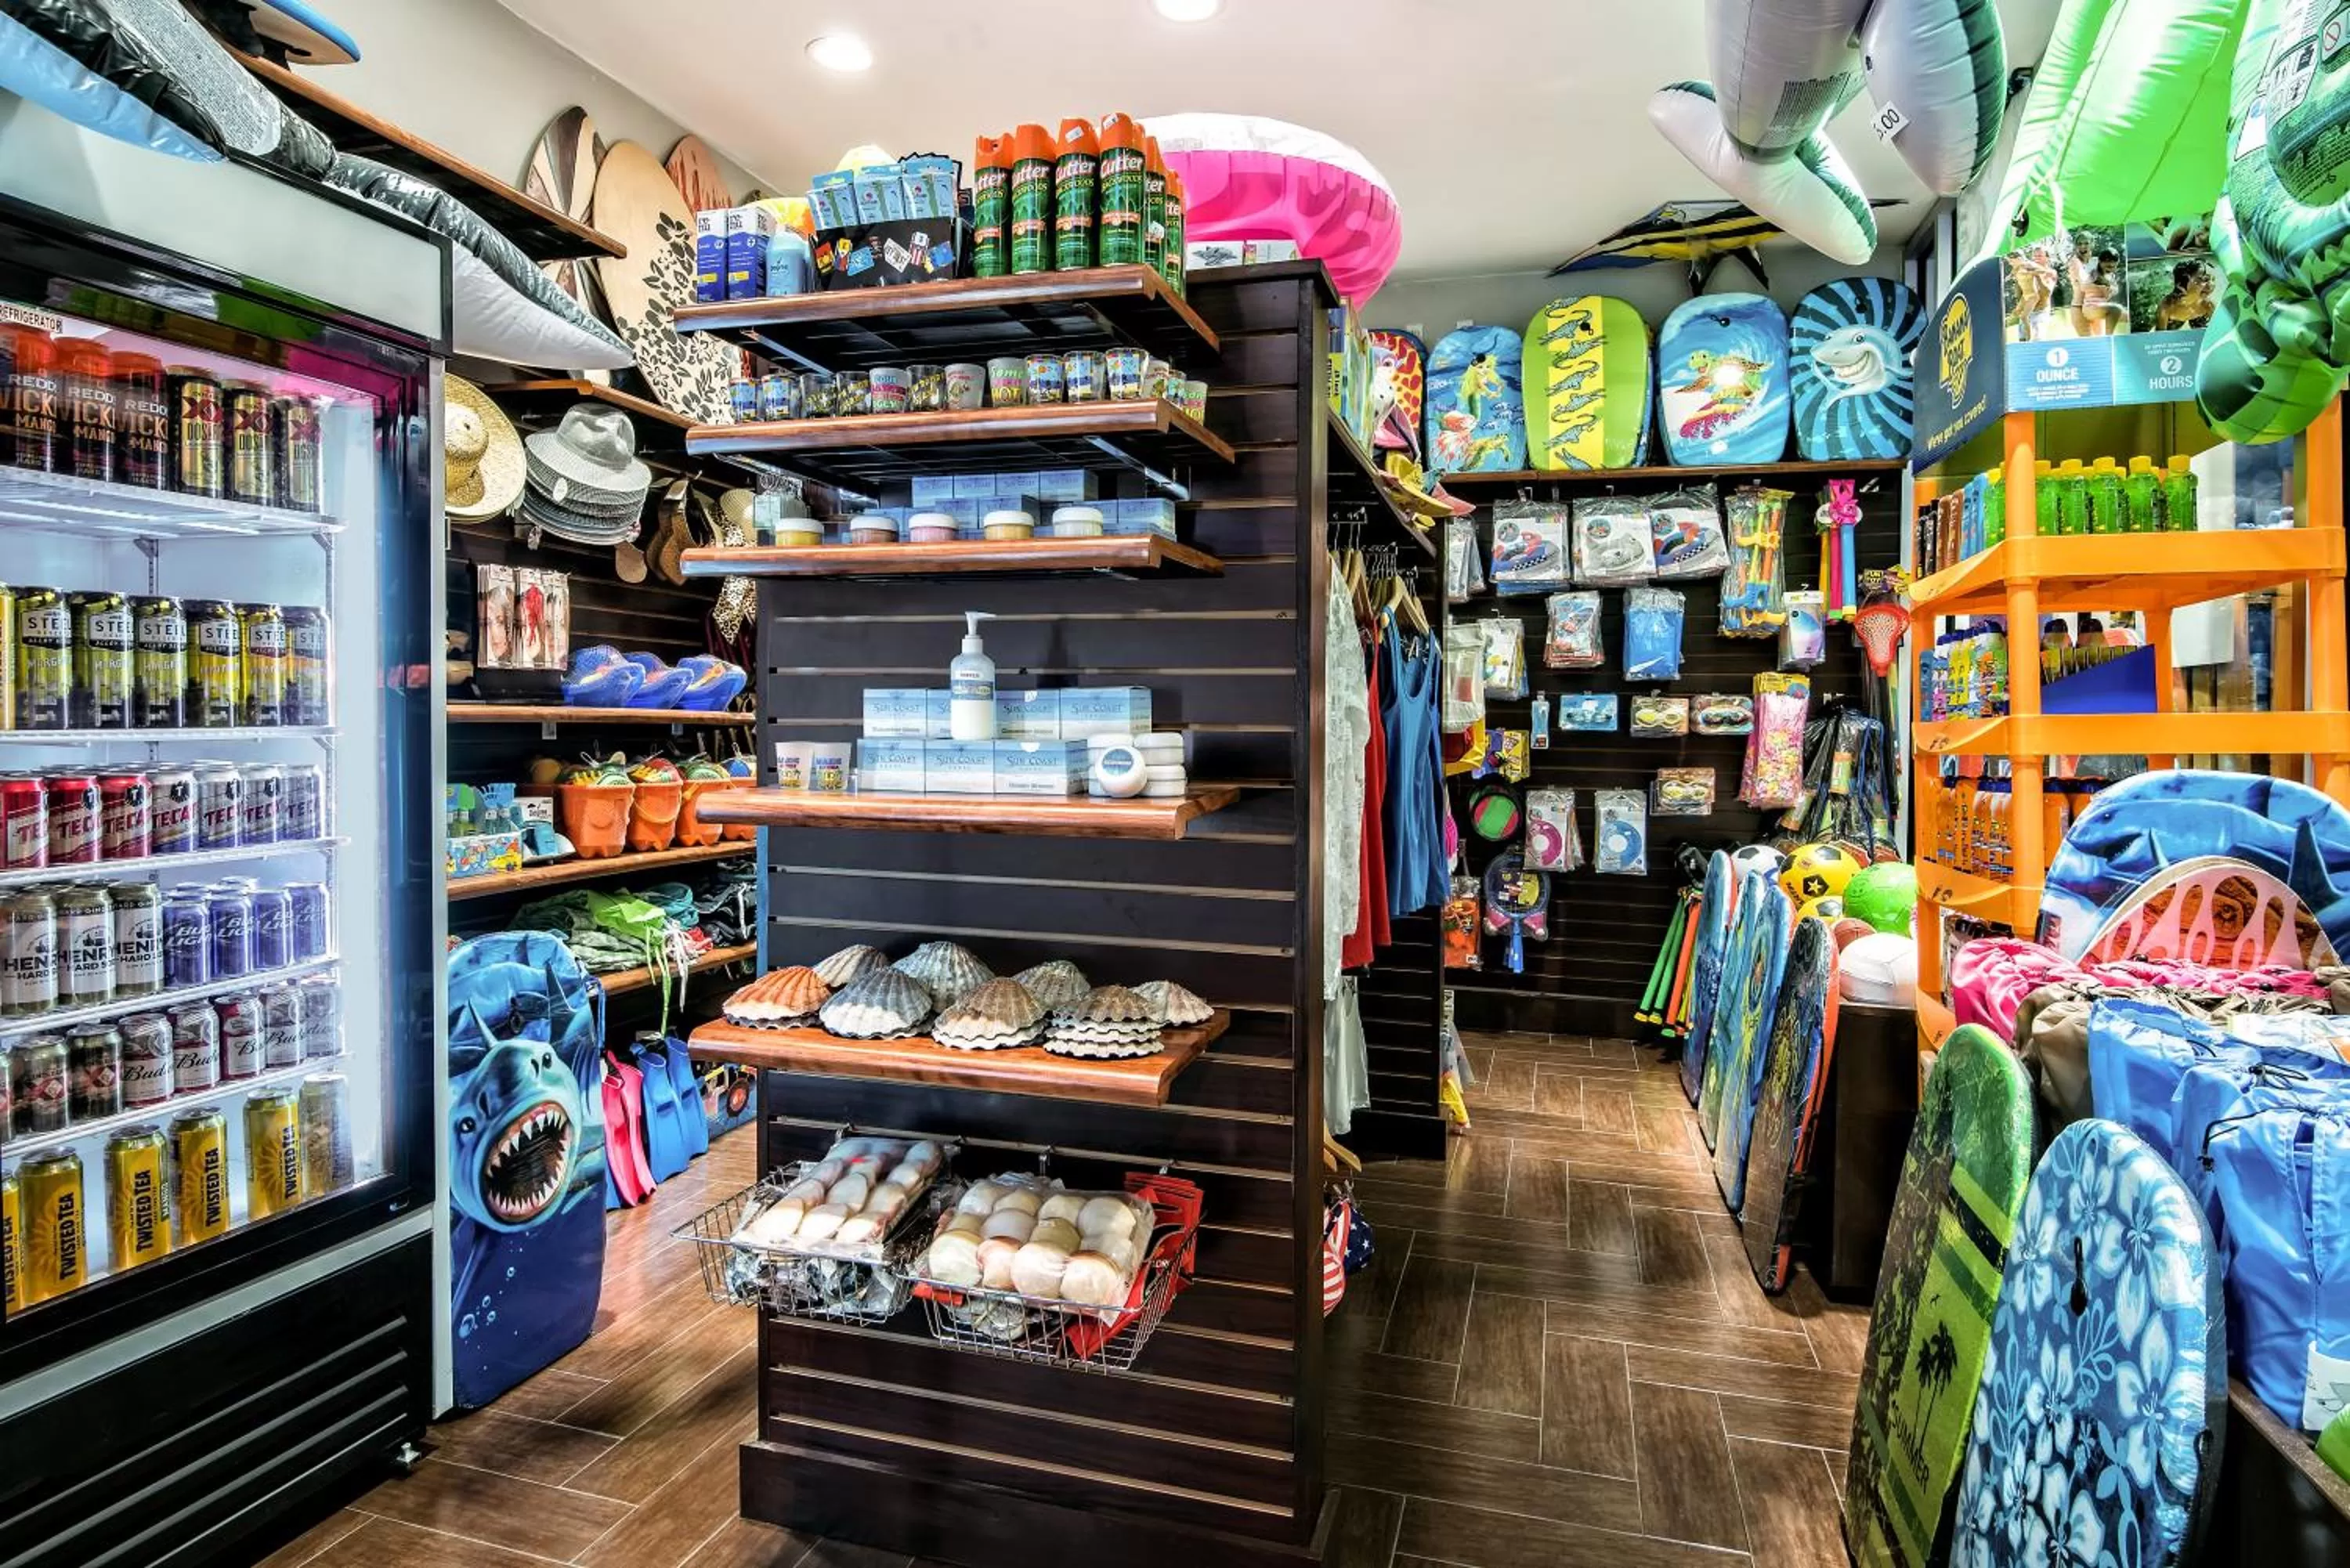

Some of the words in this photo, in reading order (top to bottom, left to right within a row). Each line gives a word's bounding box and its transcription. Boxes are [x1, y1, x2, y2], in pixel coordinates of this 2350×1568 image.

[1101, 154, 1143, 179] Cutter
[2053, 351, 2060, 364] 1
[2167, 358, 2176, 372] 2
[2036, 367, 2080, 383] OUNCE
[2149, 375, 2194, 389] HOURS
[205, 1147, 219, 1172] TEA
[135, 1169, 151, 1195] TEA
[58, 1191, 74, 1219] TEA
[206, 1172, 221, 1227] TWISTED
[136, 1195, 154, 1253] TWISTED
[59, 1219, 77, 1281] TWISTED
[1891, 1398, 1930, 1496] SUMMER
